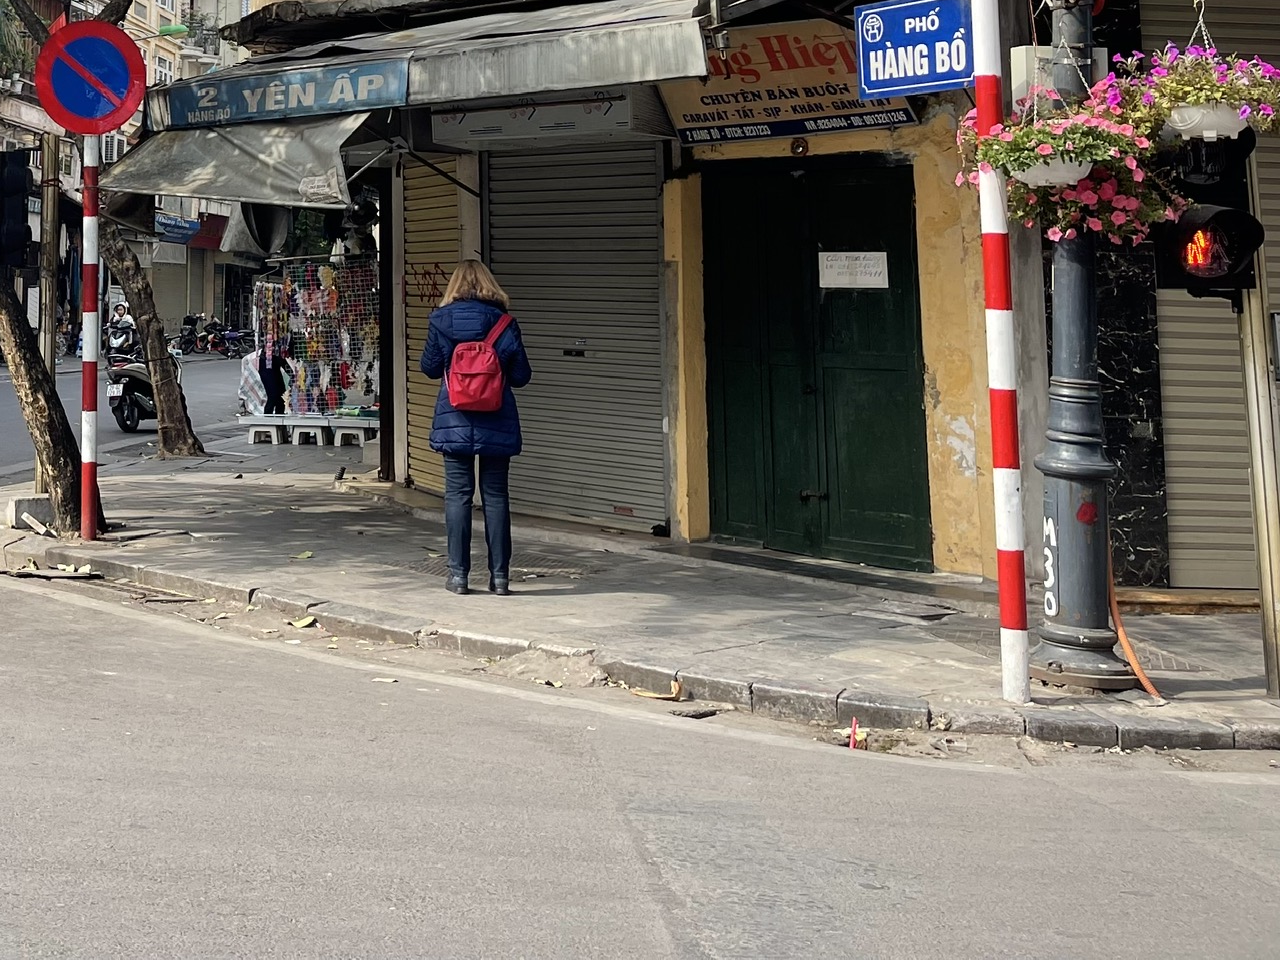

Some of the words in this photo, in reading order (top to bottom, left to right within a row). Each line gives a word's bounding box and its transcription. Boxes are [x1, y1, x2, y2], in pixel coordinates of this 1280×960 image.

[904, 6, 940, 34] PHỐ
[869, 41, 929, 81] HÀNG
[935, 28, 966, 73] BỒ
[197, 87, 218, 107] 2
[242, 80, 315, 113] YÊN
[327, 68, 385, 104] ẤP
[700, 87, 763, 106] CHUYÊN
[767, 85, 799, 101] BÁN
[188, 108, 215, 123] HÀNG
[686, 131, 692, 141] 2
